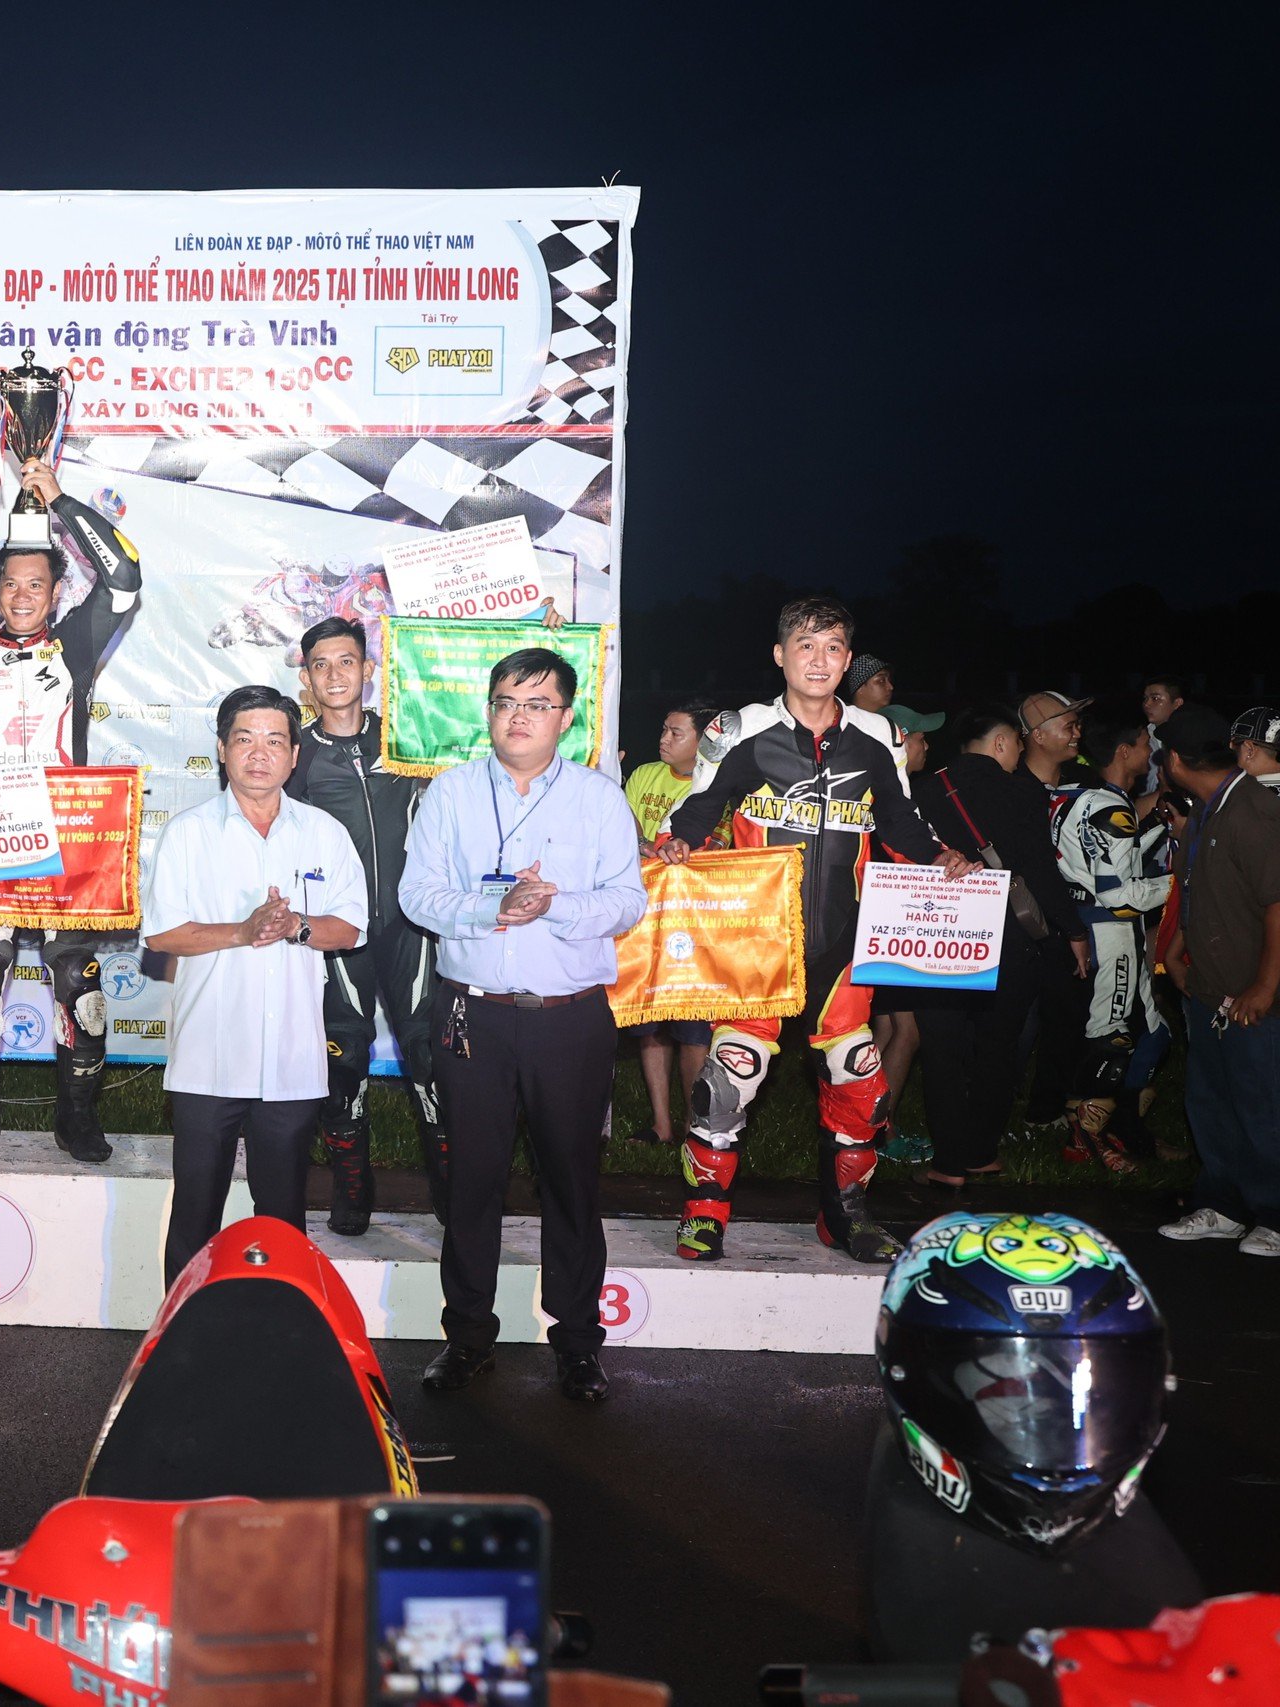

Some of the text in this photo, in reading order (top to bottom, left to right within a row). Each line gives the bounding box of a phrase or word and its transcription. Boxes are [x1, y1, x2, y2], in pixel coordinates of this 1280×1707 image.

[175, 228, 474, 253] LIÊN ĐOÀN XE ĐẠP MÔTÔ THỂ THAO VIỆT NAM
[4, 269, 42, 309] ĐẠP
[63, 262, 117, 302] MÔTÔ
[123, 256, 160, 302] THỂ
[166, 268, 213, 302] THAO
[221, 262, 266, 302] NĂM
[273, 268, 319, 301] 2025
[327, 268, 356, 308] TẠI
[363, 257, 407, 301] TỈNH
[414, 261, 459, 301] VĨNH
[467, 267, 518, 301] LONG
[421, 314, 436, 323] Tài
[48, 322, 101, 352] vận
[114, 321, 190, 352] động
[202, 320, 255, 346] Trà
[269, 320, 337, 346] Vinh
[428, 349, 466, 367] PHAT
[81, 399, 125, 418] XÂY
[207, 403, 265, 417] MIH
[472, 571, 488, 581] BA
[404, 600, 421, 610] YAZ
[408, 584, 539, 619] 000.000Đ
[739, 795, 786, 820] PHAT
[69, 812, 94, 826] QUỐC
[72, 830, 124, 843] VÒNG 4 2025
[901, 874, 924, 882] MỪNG
[906, 912, 959, 924] HẠNG TƯ
[872, 925, 889, 934] YAZ
[917, 925, 955, 937] CHUYÊN
[958, 929, 993, 940] NGHIỆP
[867, 937, 989, 961] 5.000.000Đ
[114, 1020, 143, 1035] PHAT
[599, 1284, 631, 1326] 3
[1020, 1289, 1066, 1311] agv
